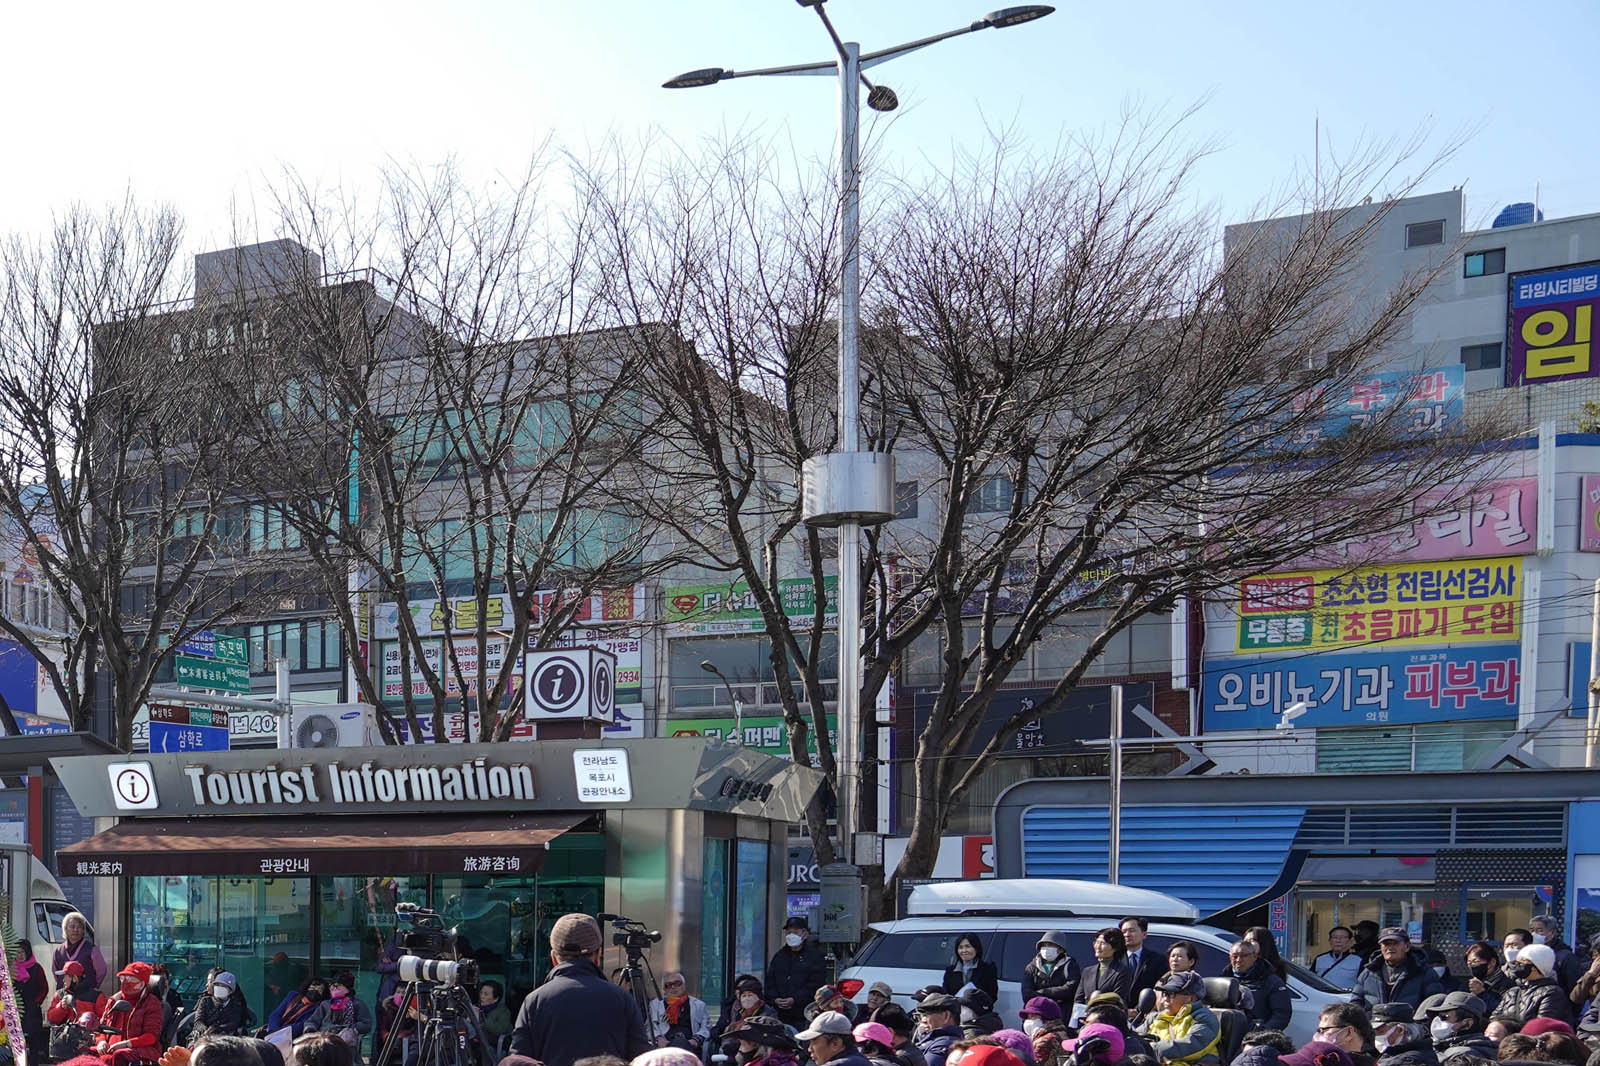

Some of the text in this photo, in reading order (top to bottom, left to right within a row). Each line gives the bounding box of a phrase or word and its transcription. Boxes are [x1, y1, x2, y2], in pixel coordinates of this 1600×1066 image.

[1520, 275, 1598, 299] 타임시티빌딩
[1521, 304, 1592, 379] 임
[1396, 564, 1515, 600] 전립선검사
[1344, 607, 1448, 641] 초음파기
[1461, 602, 1514, 635] 도입
[1213, 658, 1521, 714] 오비뇨기과 피부과
[1365, 711, 1388, 722] 의원
[582, 756, 618, 765] 전라남도
[184, 760, 535, 806] Tourist Information
[589, 773, 615, 782] 목포시
[582, 787, 626, 796] 관광안내소
[77, 862, 122, 875] 観光案内
[260, 858, 310, 873] 관광안내
[463, 856, 520, 872] 旅游咨询
